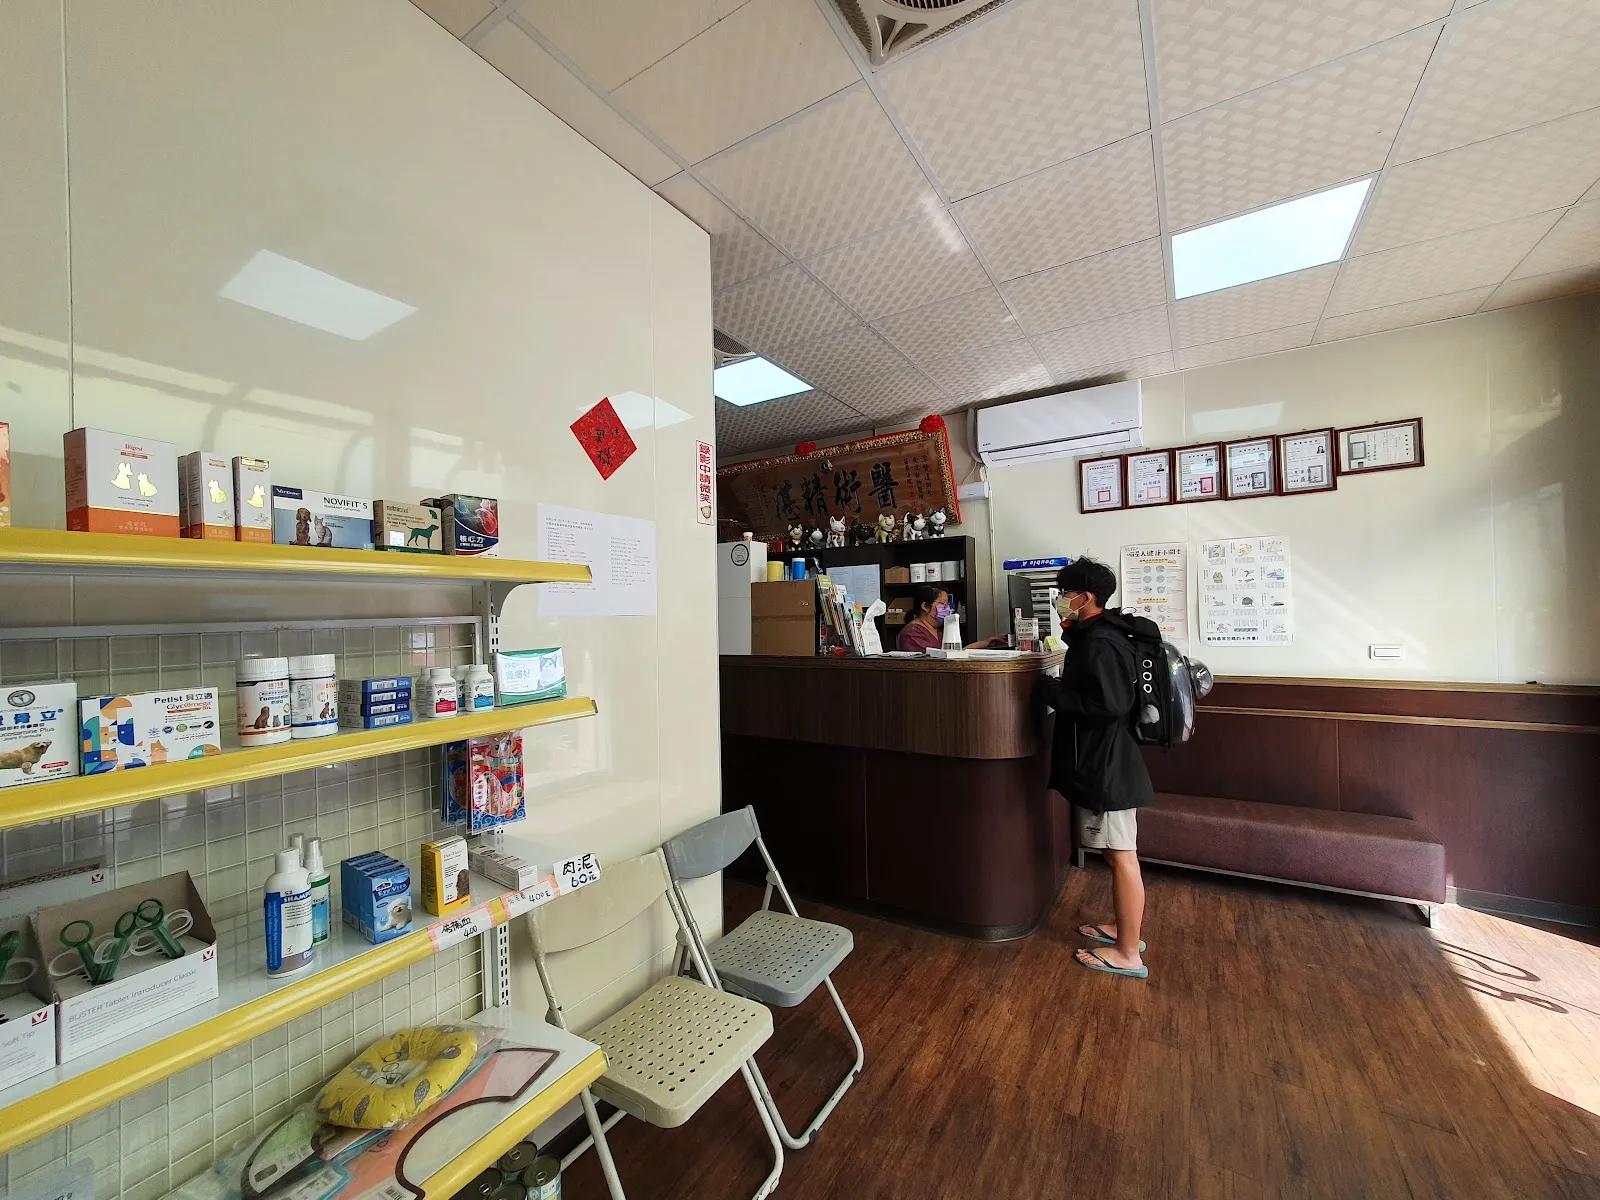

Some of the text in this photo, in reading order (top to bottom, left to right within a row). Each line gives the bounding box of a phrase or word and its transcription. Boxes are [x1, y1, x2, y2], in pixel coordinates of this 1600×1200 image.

[459, 534, 483, 544] 核心力
[562, 853, 594, 876] 肉泥
[571, 870, 597, 888] 60元
[463, 925, 478, 938] 400
[68, 967, 198, 1023] BUSTER Tablet Introducer Classic
[21, 1030, 35, 1040] Tip
